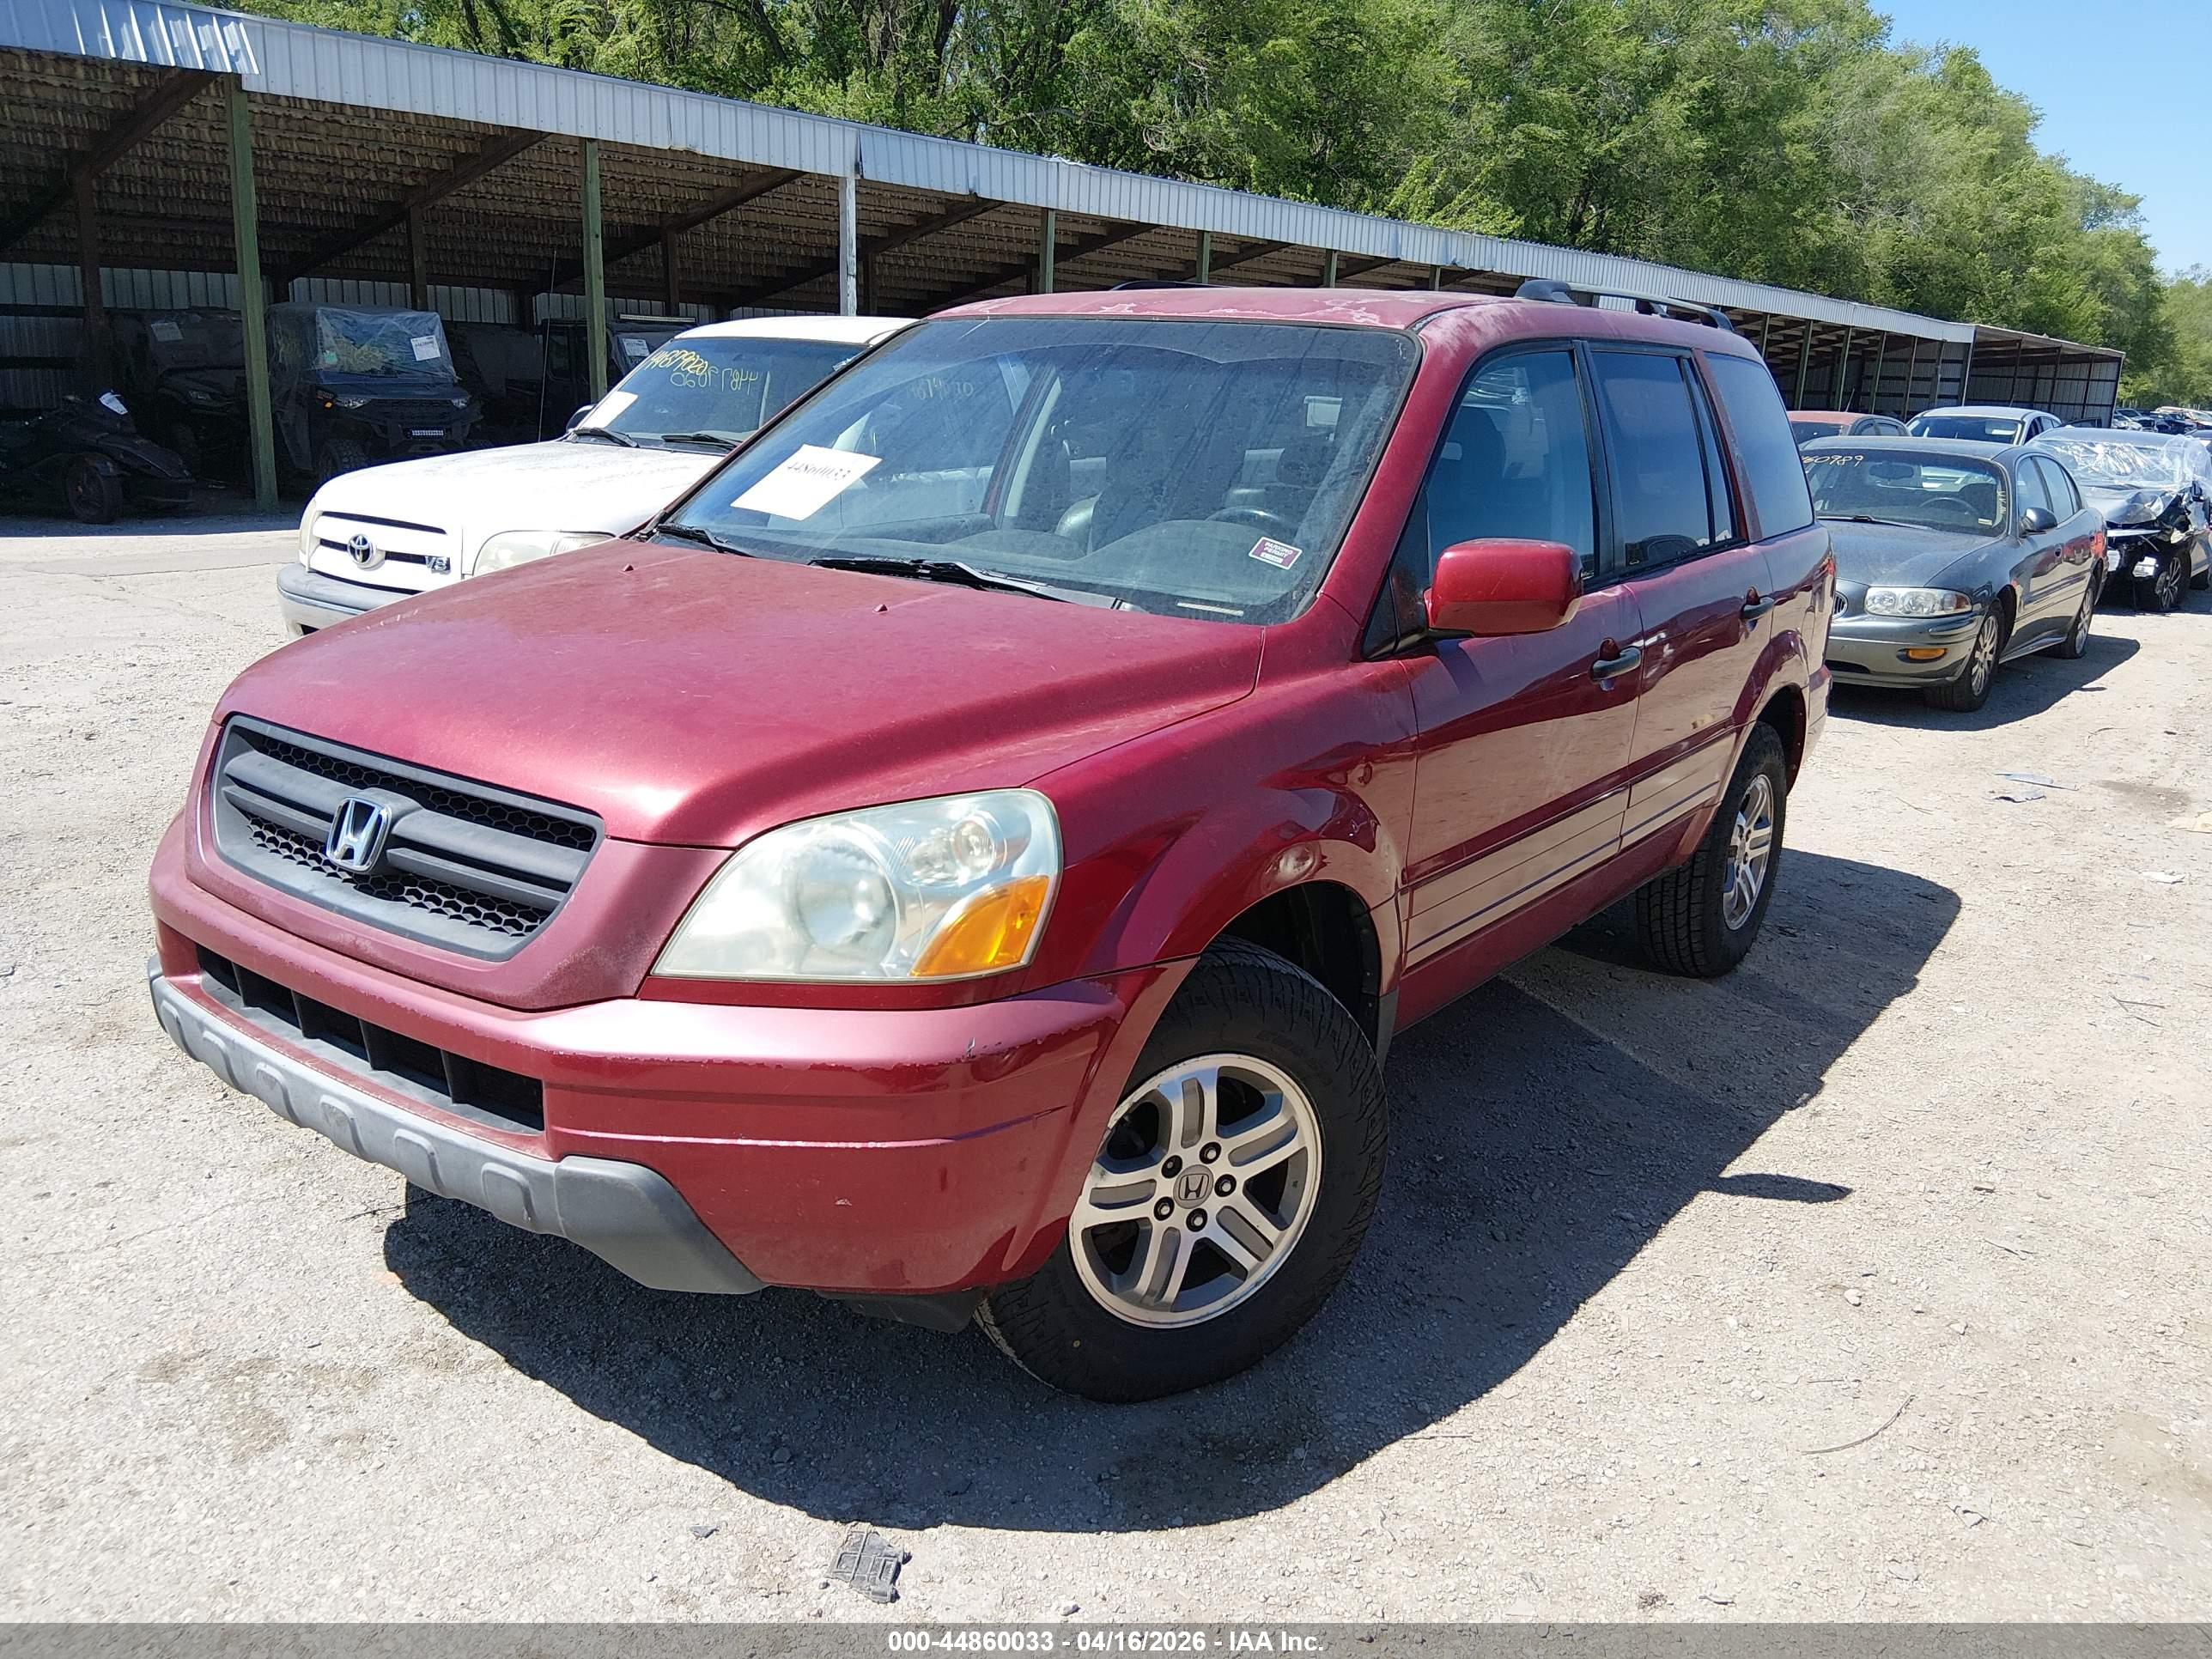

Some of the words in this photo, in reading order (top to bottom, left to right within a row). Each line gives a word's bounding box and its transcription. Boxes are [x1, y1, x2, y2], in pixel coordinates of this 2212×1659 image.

[1263, 547, 1289, 558] PERMIT
[1264, 542, 1293, 555] PARKING
[425, 556, 447, 571] V8
